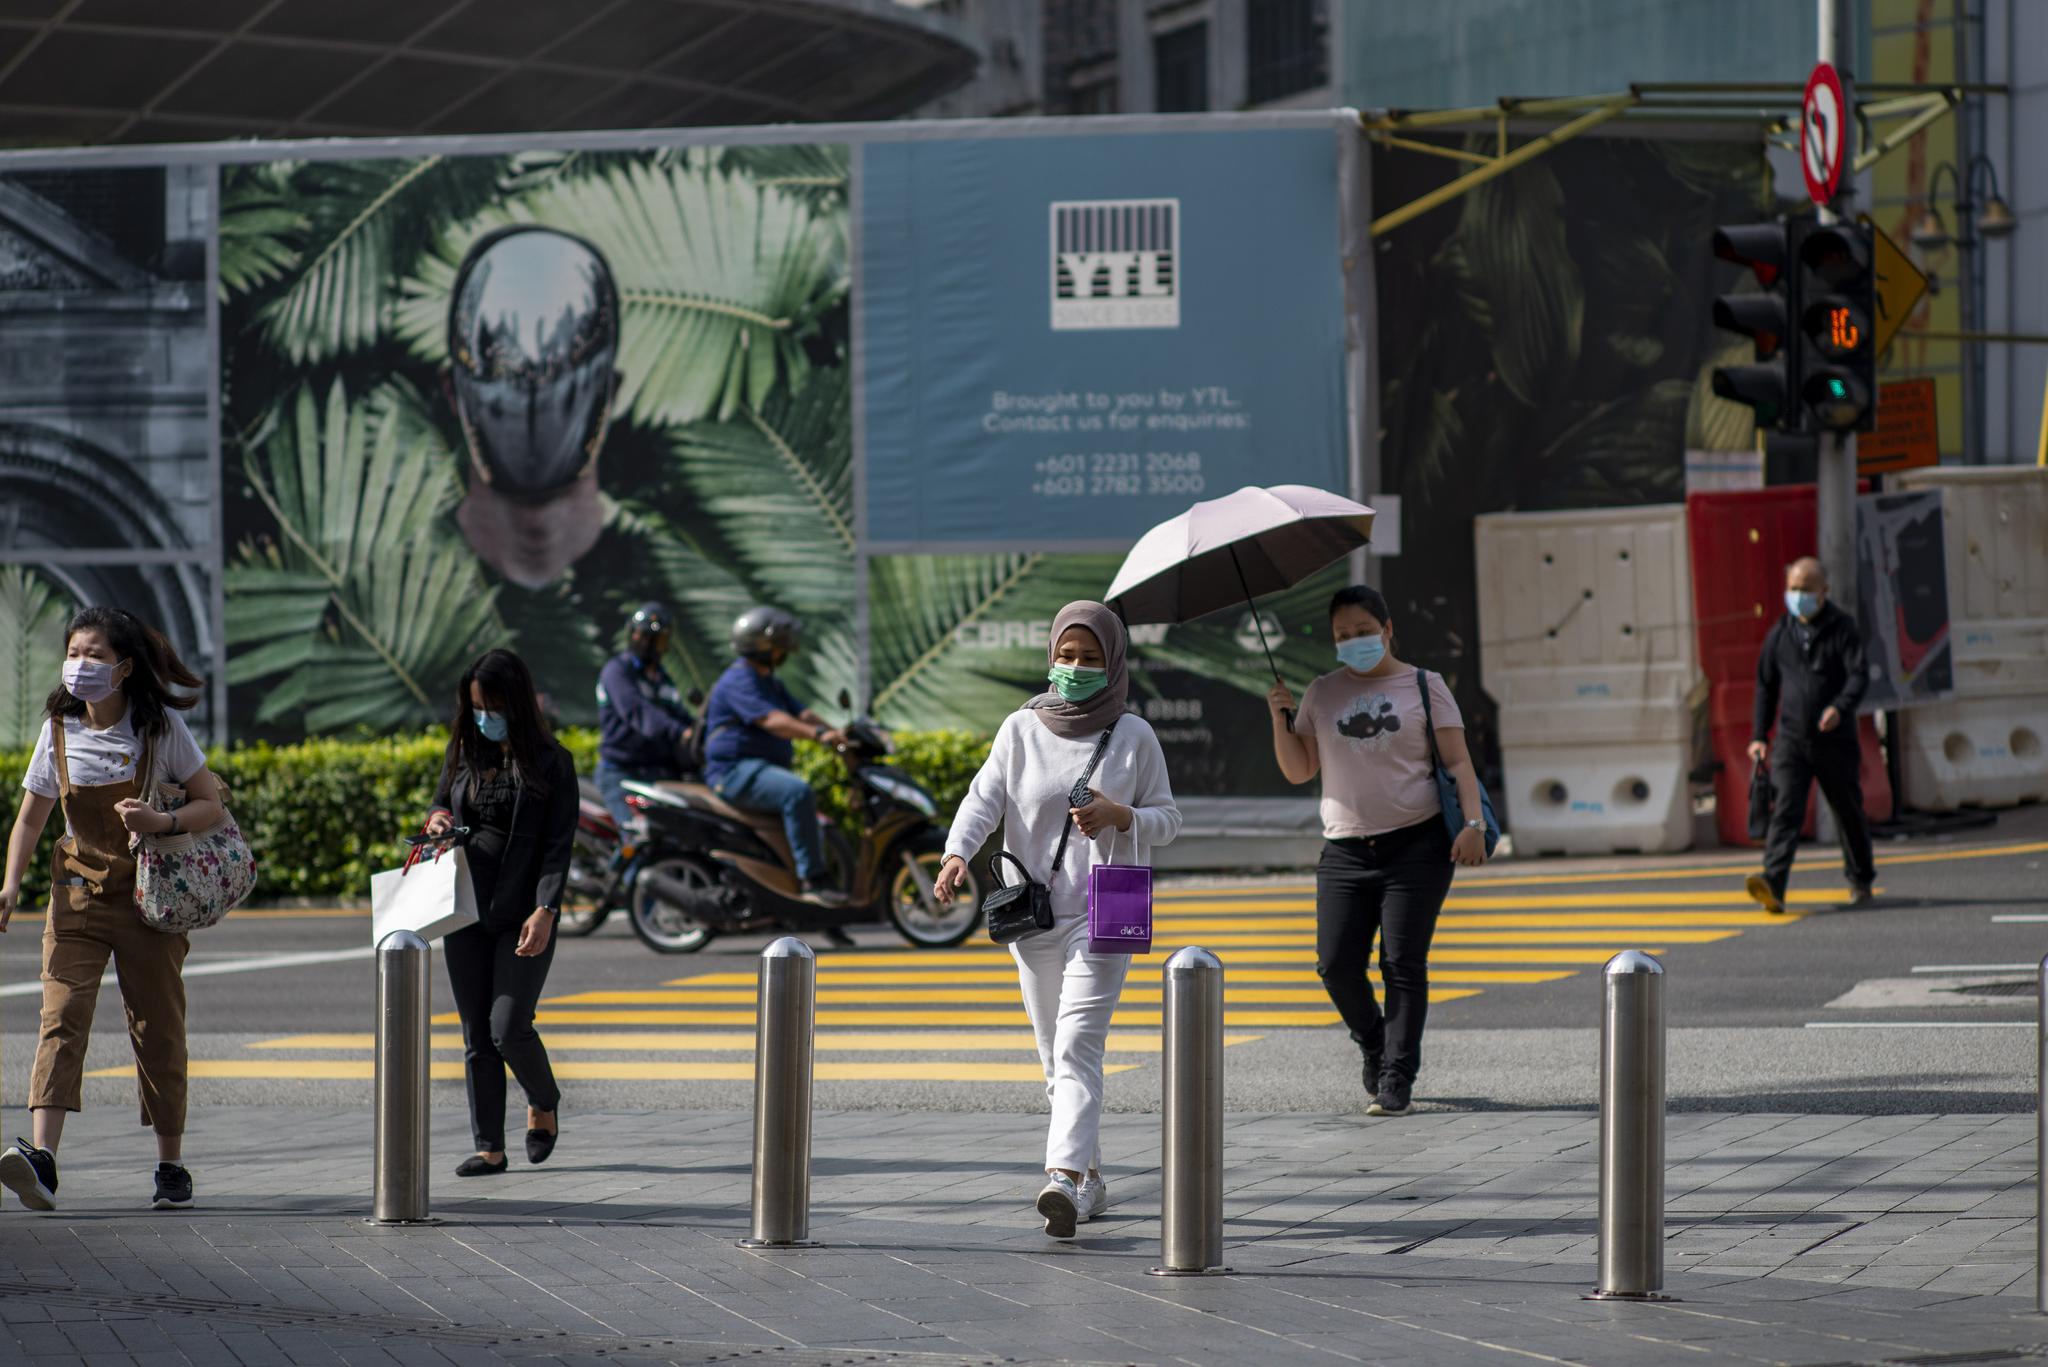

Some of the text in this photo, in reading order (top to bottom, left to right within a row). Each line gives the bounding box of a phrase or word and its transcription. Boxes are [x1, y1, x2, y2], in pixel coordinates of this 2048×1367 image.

[1060, 251, 1172, 298] YTL
[992, 390, 1079, 412] Brought
[1086, 391, 1110, 409] to
[1114, 393, 1153, 413] you
[1160, 388, 1186, 410] by
[983, 411, 1252, 432] Contact us for enquiries:
[1035, 451, 1201, 473] +601 2231 2068
[1032, 473, 1206, 496] +603 2782 3500
[955, 621, 1049, 648] CBRE
